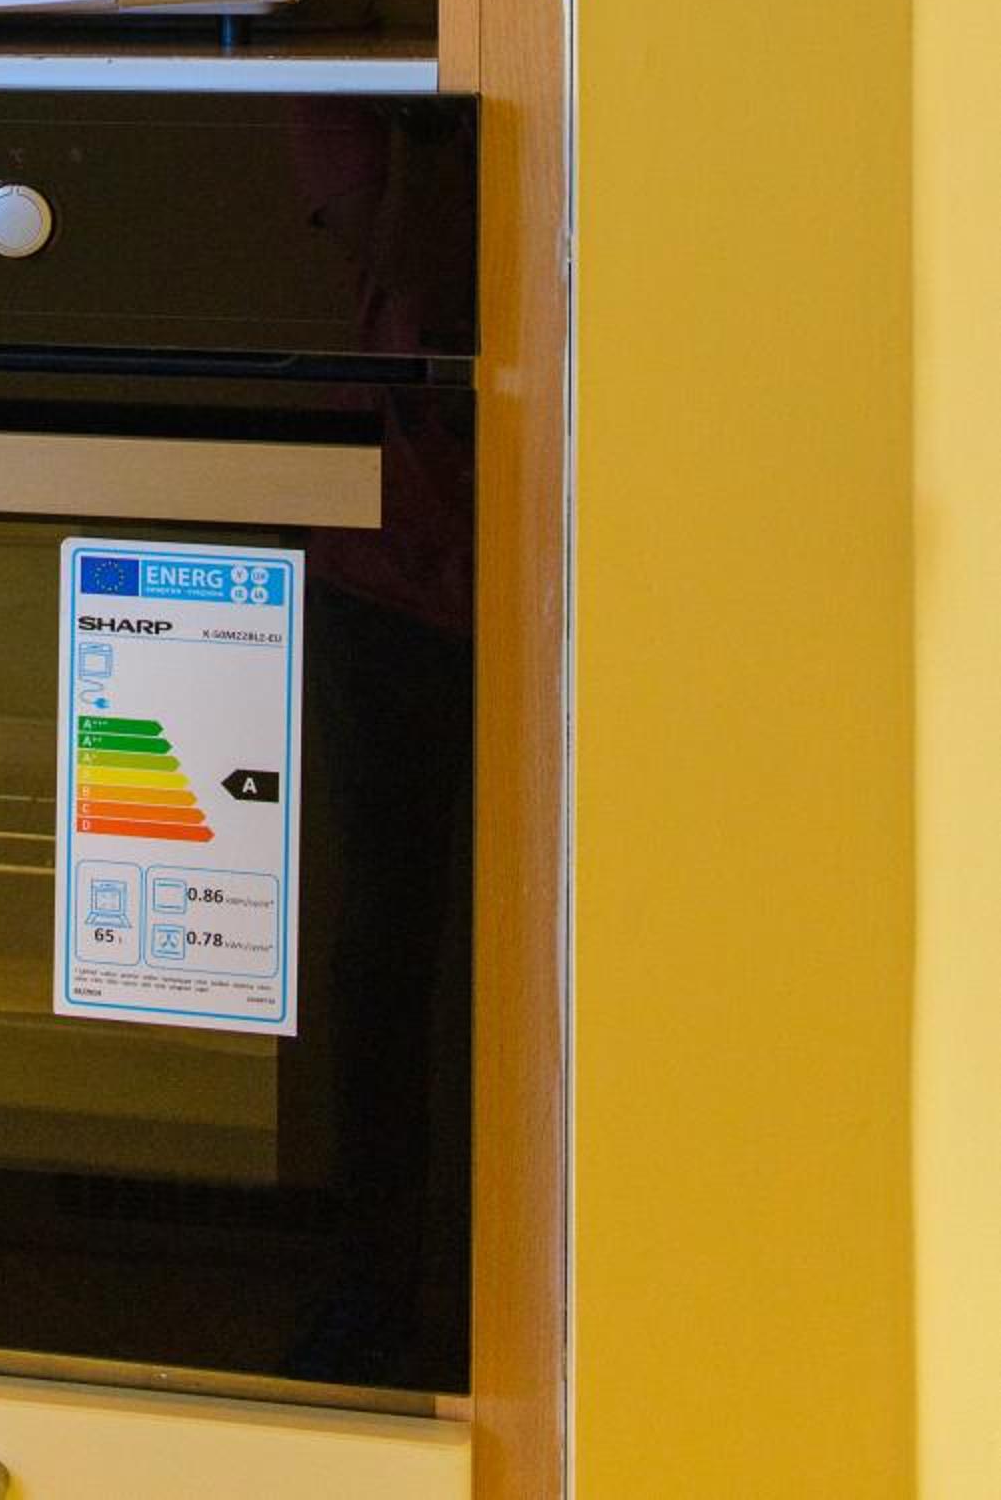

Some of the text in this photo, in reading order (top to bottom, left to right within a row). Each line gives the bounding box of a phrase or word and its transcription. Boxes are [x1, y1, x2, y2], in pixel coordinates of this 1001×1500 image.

[146, 565, 224, 589] ENERG
[78, 615, 173, 636] SHARP
[242, 777, 258, 794] A
[82, 819, 92, 831] D
[187, 887, 224, 904] 0.86
[94, 927, 114, 943] 65
[186, 931, 223, 948] 0.78
